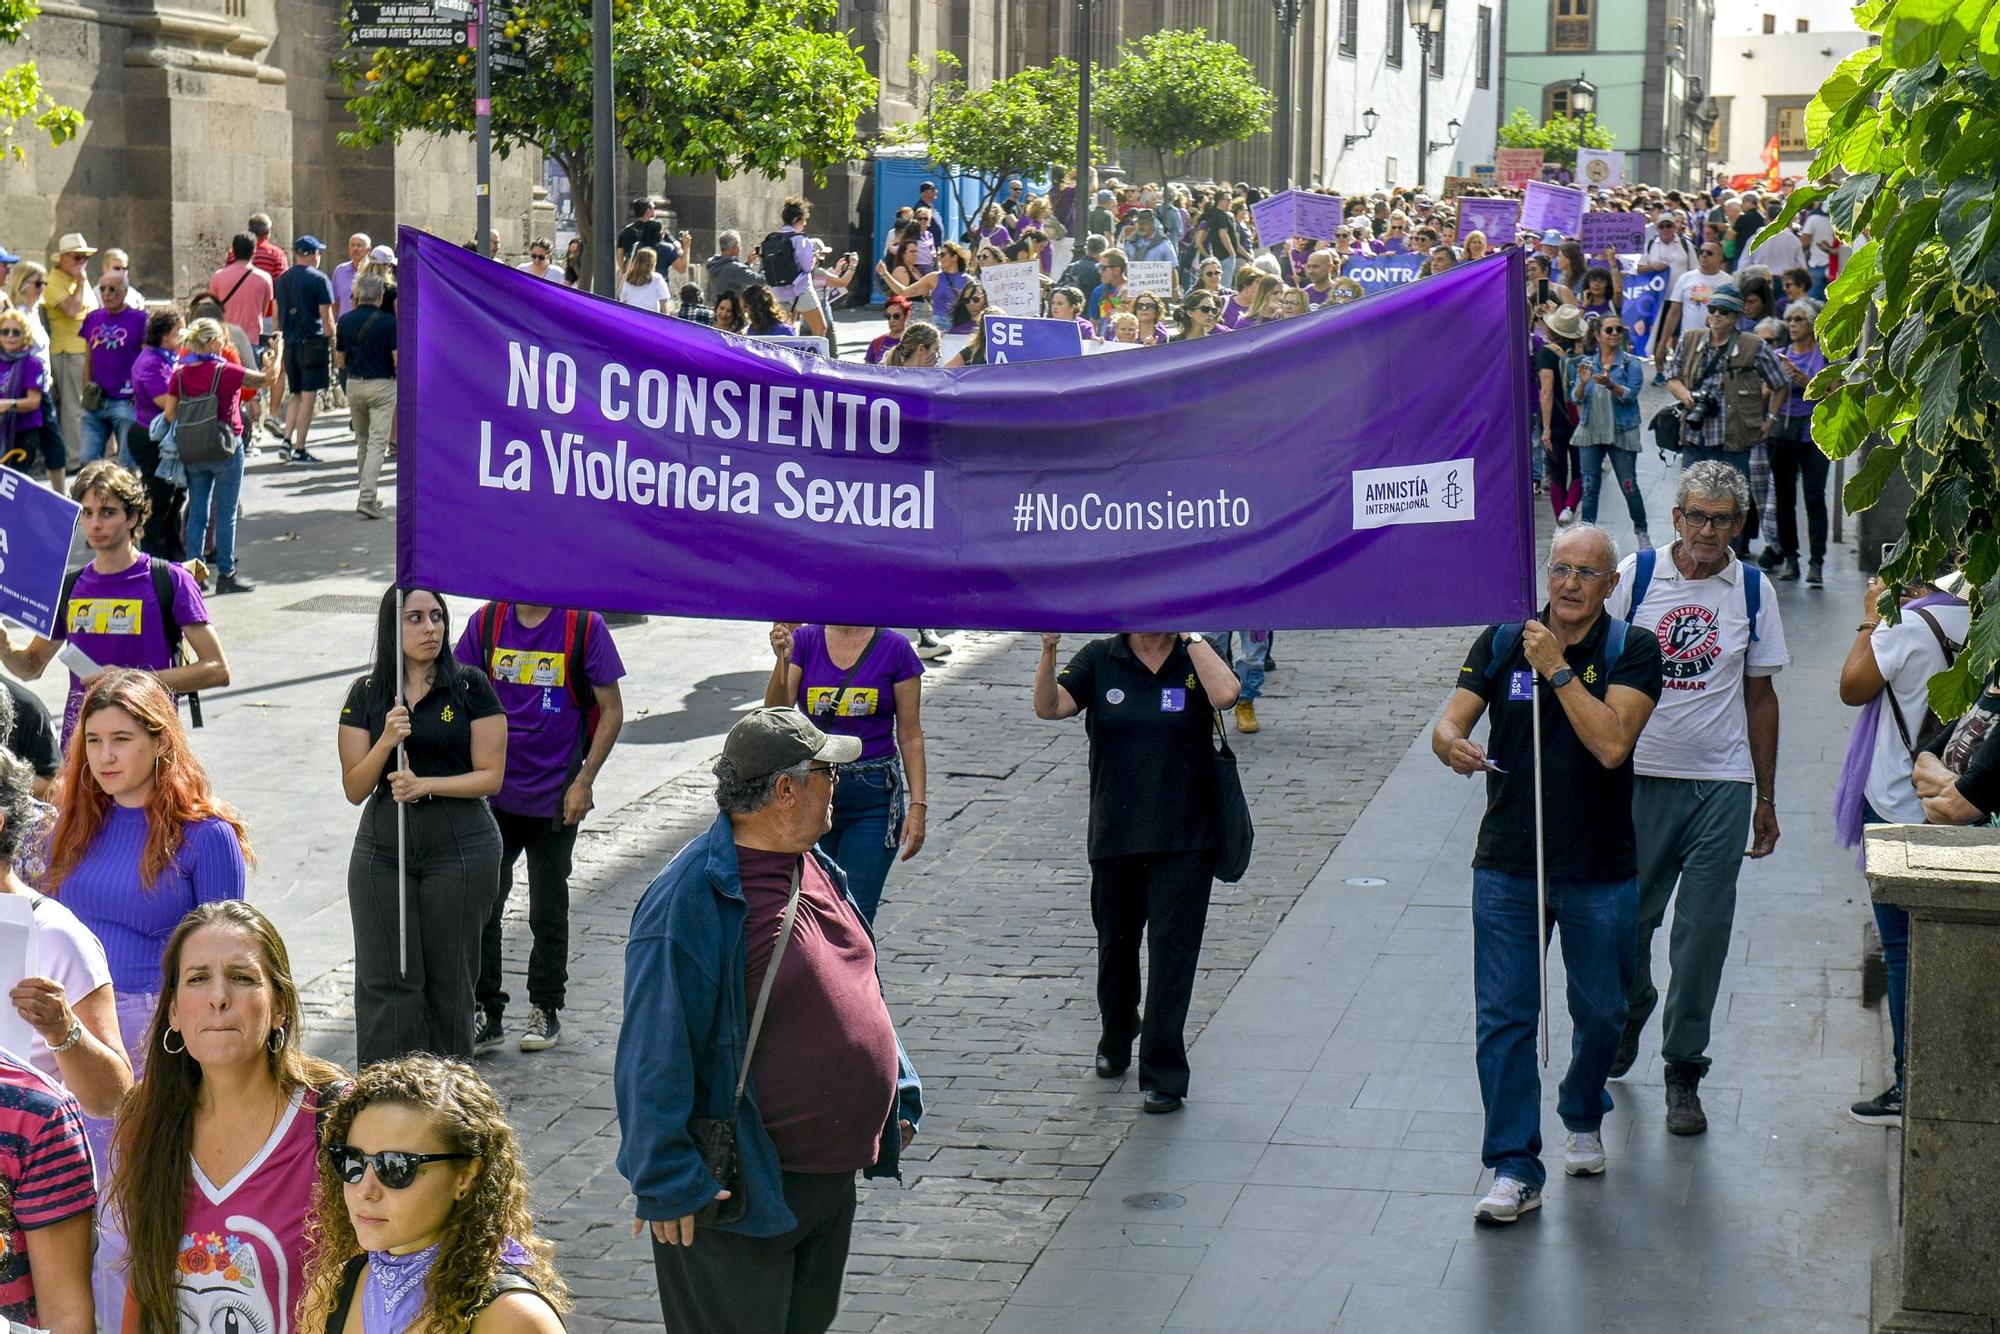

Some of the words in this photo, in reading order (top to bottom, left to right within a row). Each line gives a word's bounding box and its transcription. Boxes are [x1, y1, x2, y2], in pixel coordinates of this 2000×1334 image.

[380, 6, 396, 16] SAN
[397, 6, 430, 16] ANTONIO
[359, 28, 388, 39] CENTRO
[388, 28, 412, 38] ARTES
[413, 27, 452, 39] PLÁSTICAS
[991, 322, 1024, 346] SE
[507, 340, 577, 415] NO
[600, 362, 901, 454] CONSIENTO
[479, 420, 532, 492] La
[541, 429, 760, 515] Violencia
[774, 461, 935, 530] Sexual
[1366, 475, 1428, 501] AMNISTÍA
[1013, 489, 1250, 532] #NoConsiento
[1366, 497, 1430, 515] INTERNACIONAL
[1660, 607, 1710, 629] SOLIDARIDAD
[1686, 631, 1717, 658] POPULAR
